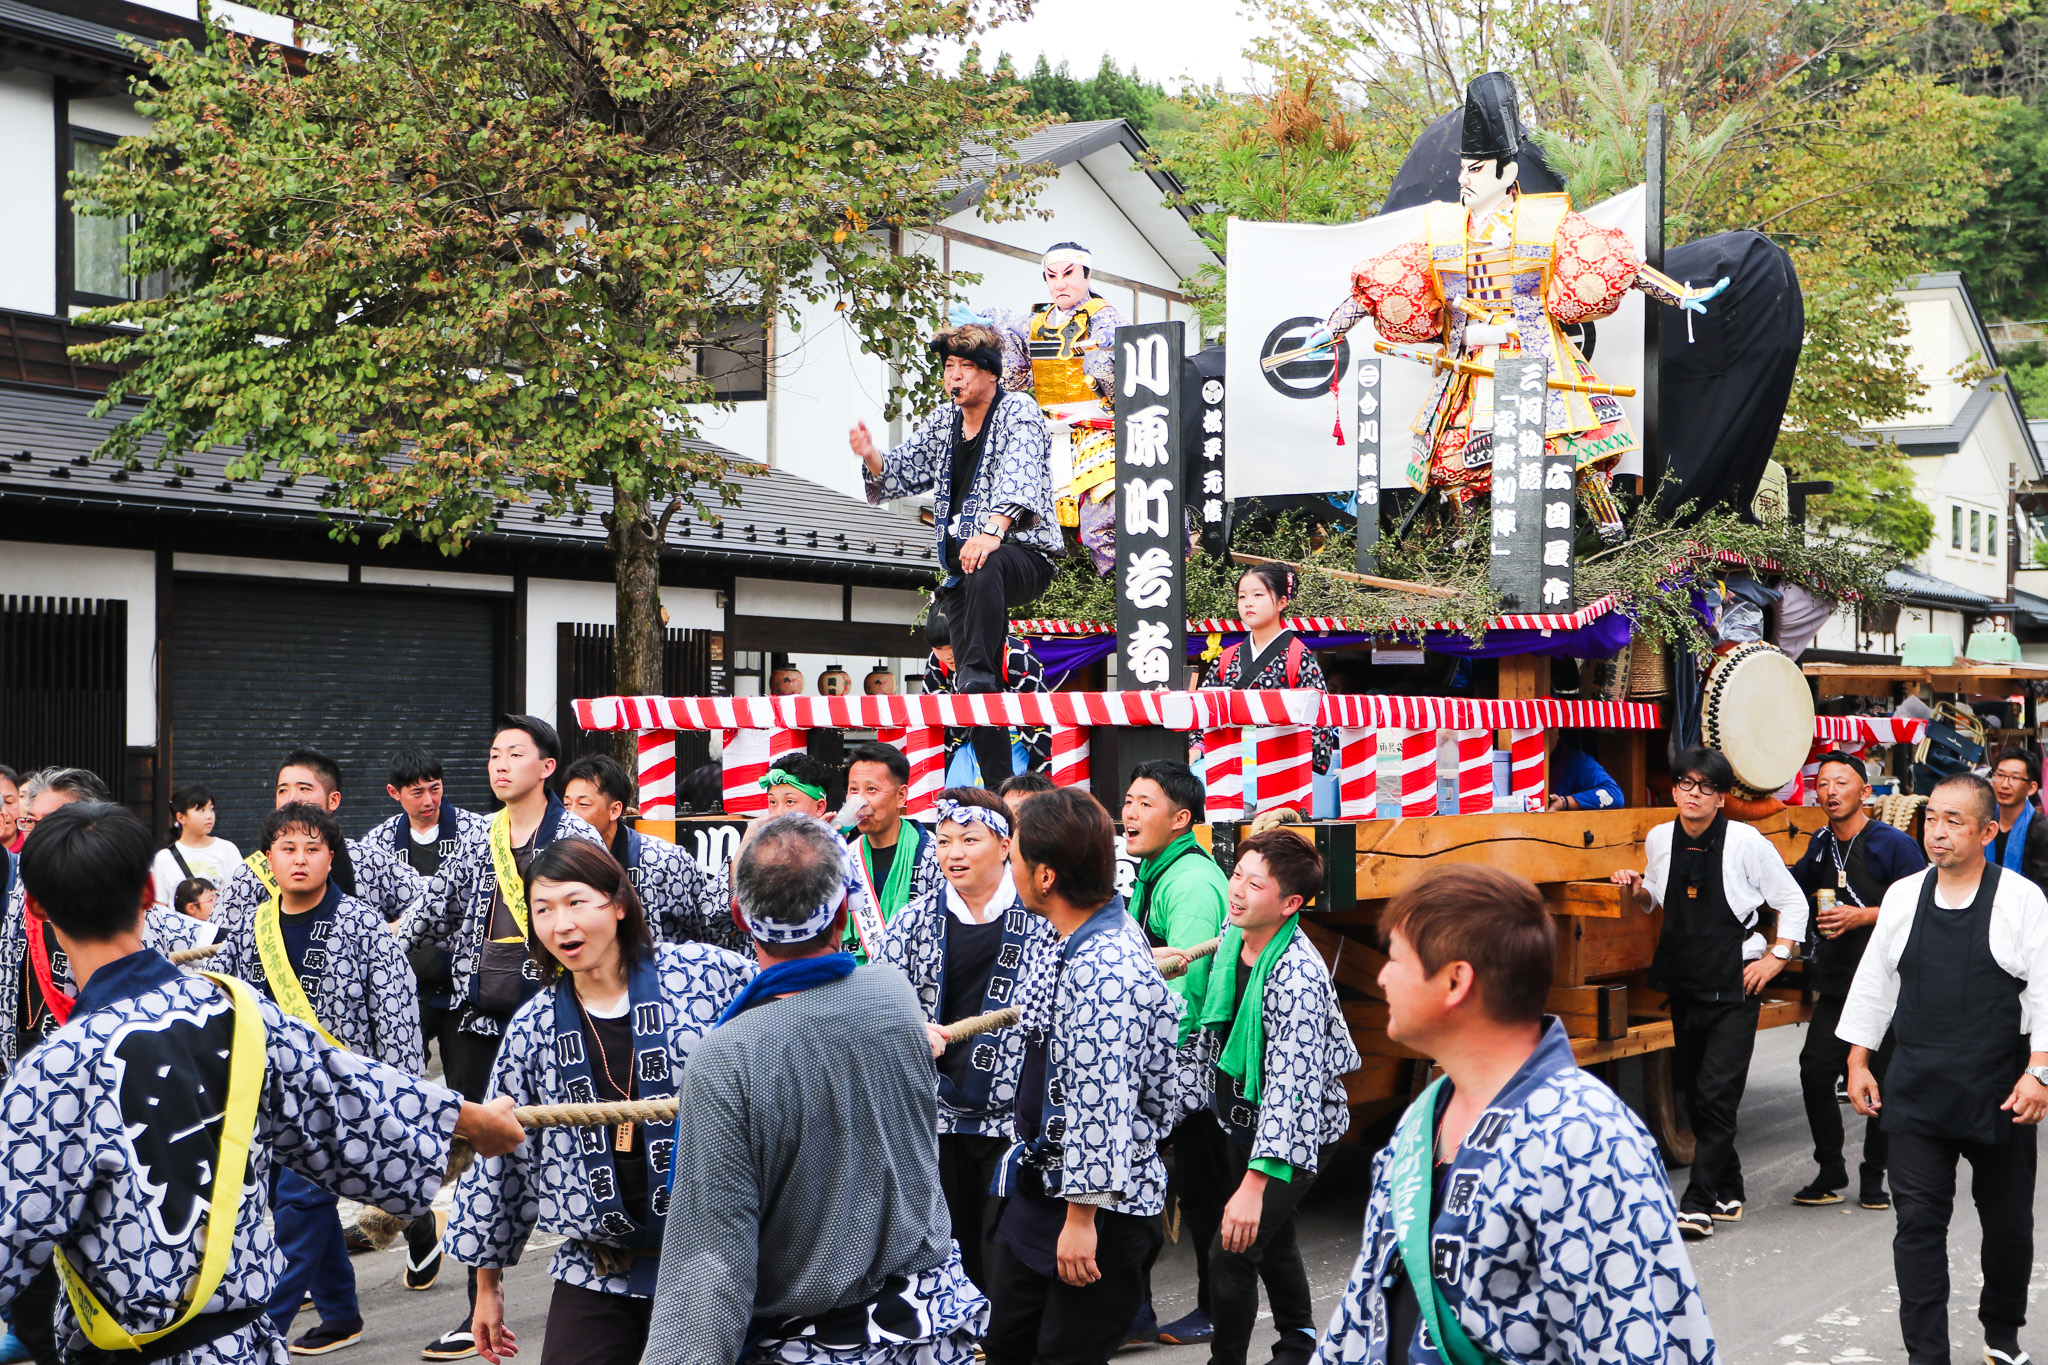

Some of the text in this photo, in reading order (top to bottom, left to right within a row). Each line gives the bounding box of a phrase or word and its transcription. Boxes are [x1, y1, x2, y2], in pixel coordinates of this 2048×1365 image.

[1123, 332, 1174, 684] 川原町若者
[1202, 409, 1224, 523] 松平元信
[1357, 391, 1379, 506] 今川義元
[972, 909, 1028, 1072] 川原町者
